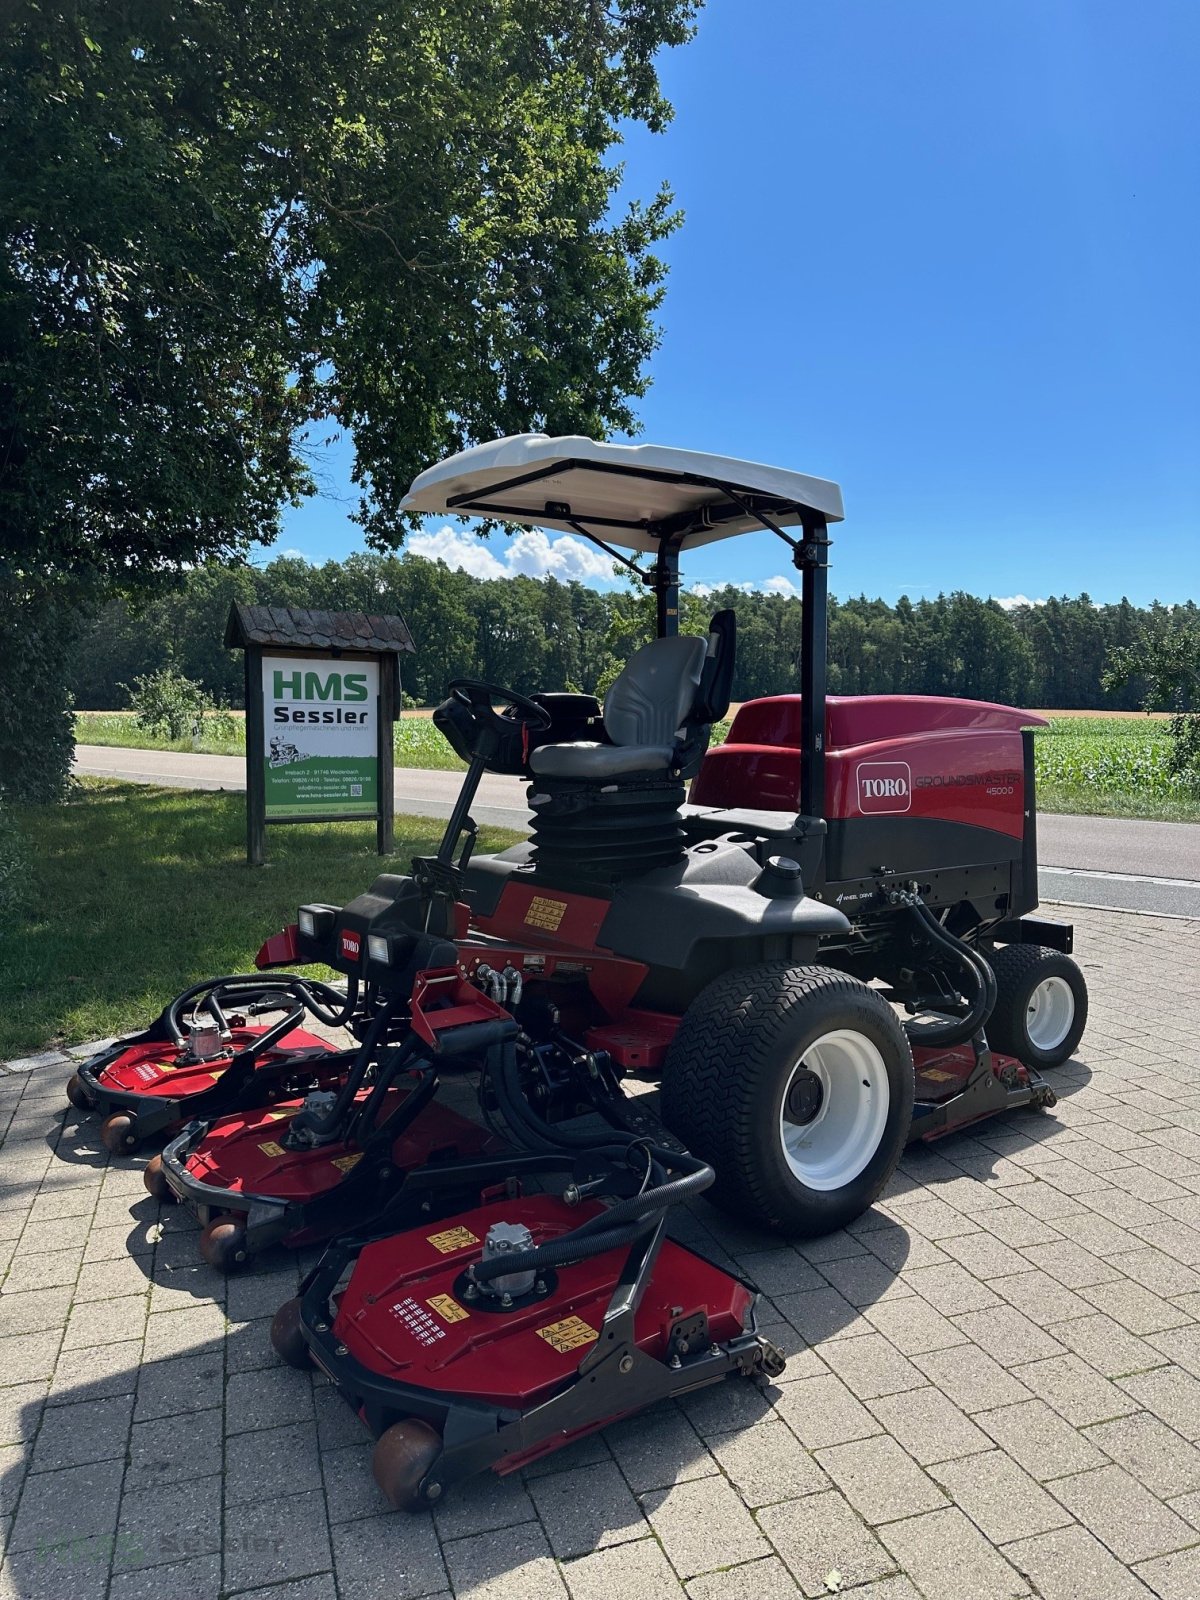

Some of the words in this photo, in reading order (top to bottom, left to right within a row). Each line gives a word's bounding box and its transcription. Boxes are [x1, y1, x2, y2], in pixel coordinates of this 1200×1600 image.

[273, 670, 368, 701] HMS
[273, 706, 368, 723] Sessler
[340, 724, 352, 732] und
[862, 778, 907, 798] TORO
[915, 773, 1021, 788] GROUNDSMASTER
[296, 791, 349, 799] www.hms-sessler.de
[342, 937, 360, 954] TORO
